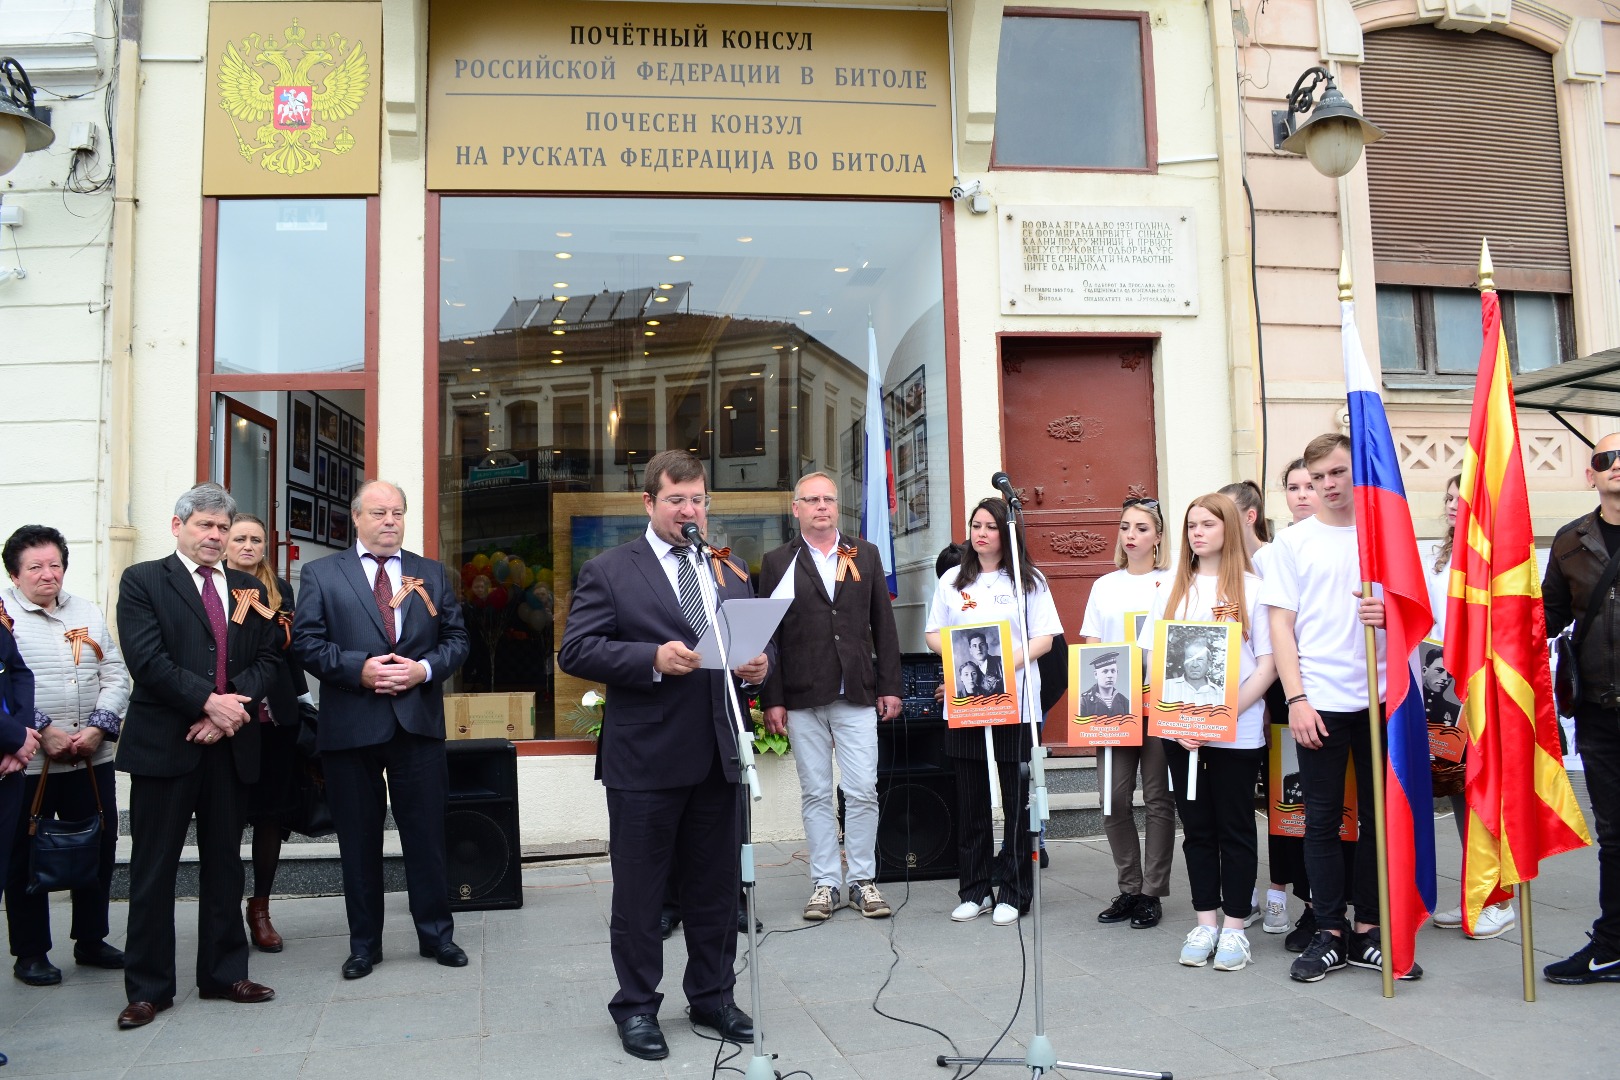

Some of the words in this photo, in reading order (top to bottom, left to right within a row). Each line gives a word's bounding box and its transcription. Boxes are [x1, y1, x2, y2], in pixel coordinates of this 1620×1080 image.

[570, 22, 709, 48] ПОЧЁТНЫЙ
[721, 29, 814, 51] КОНСУЛ
[454, 54, 617, 81] РОССИЙСКОЙ
[635, 60, 782, 87] ФЕДЕРАЦИИ
[799, 66, 815, 86] В
[834, 66, 928, 90] БИТОЛЕ
[585, 111, 698, 134] ПОЧЕСЕН
[710, 113, 803, 136] КОНЗУЛ
[455, 145, 488, 166] НА
[501, 145, 607, 168] РУСКАТА
[619, 146, 775, 175] ФЕДЕРАЦИЈА
[787, 151, 819, 171] ВО
[831, 151, 928, 174] БИТОЛА
[1021, 220, 1034, 229] ВО
[1035, 220, 1062, 229] ОВАА
[1103, 221, 1115, 229] ВО
[1022, 229, 1033, 238] СЕ
[1035, 229, 1094, 238] ФОРМИРАНИ
[1096, 229, 1131, 238] ПРВИТЕ
[1107, 246, 1138, 255] ОДБОР
[1140, 246, 1154, 255] НА
[1051, 262, 1065, 272] ОД
